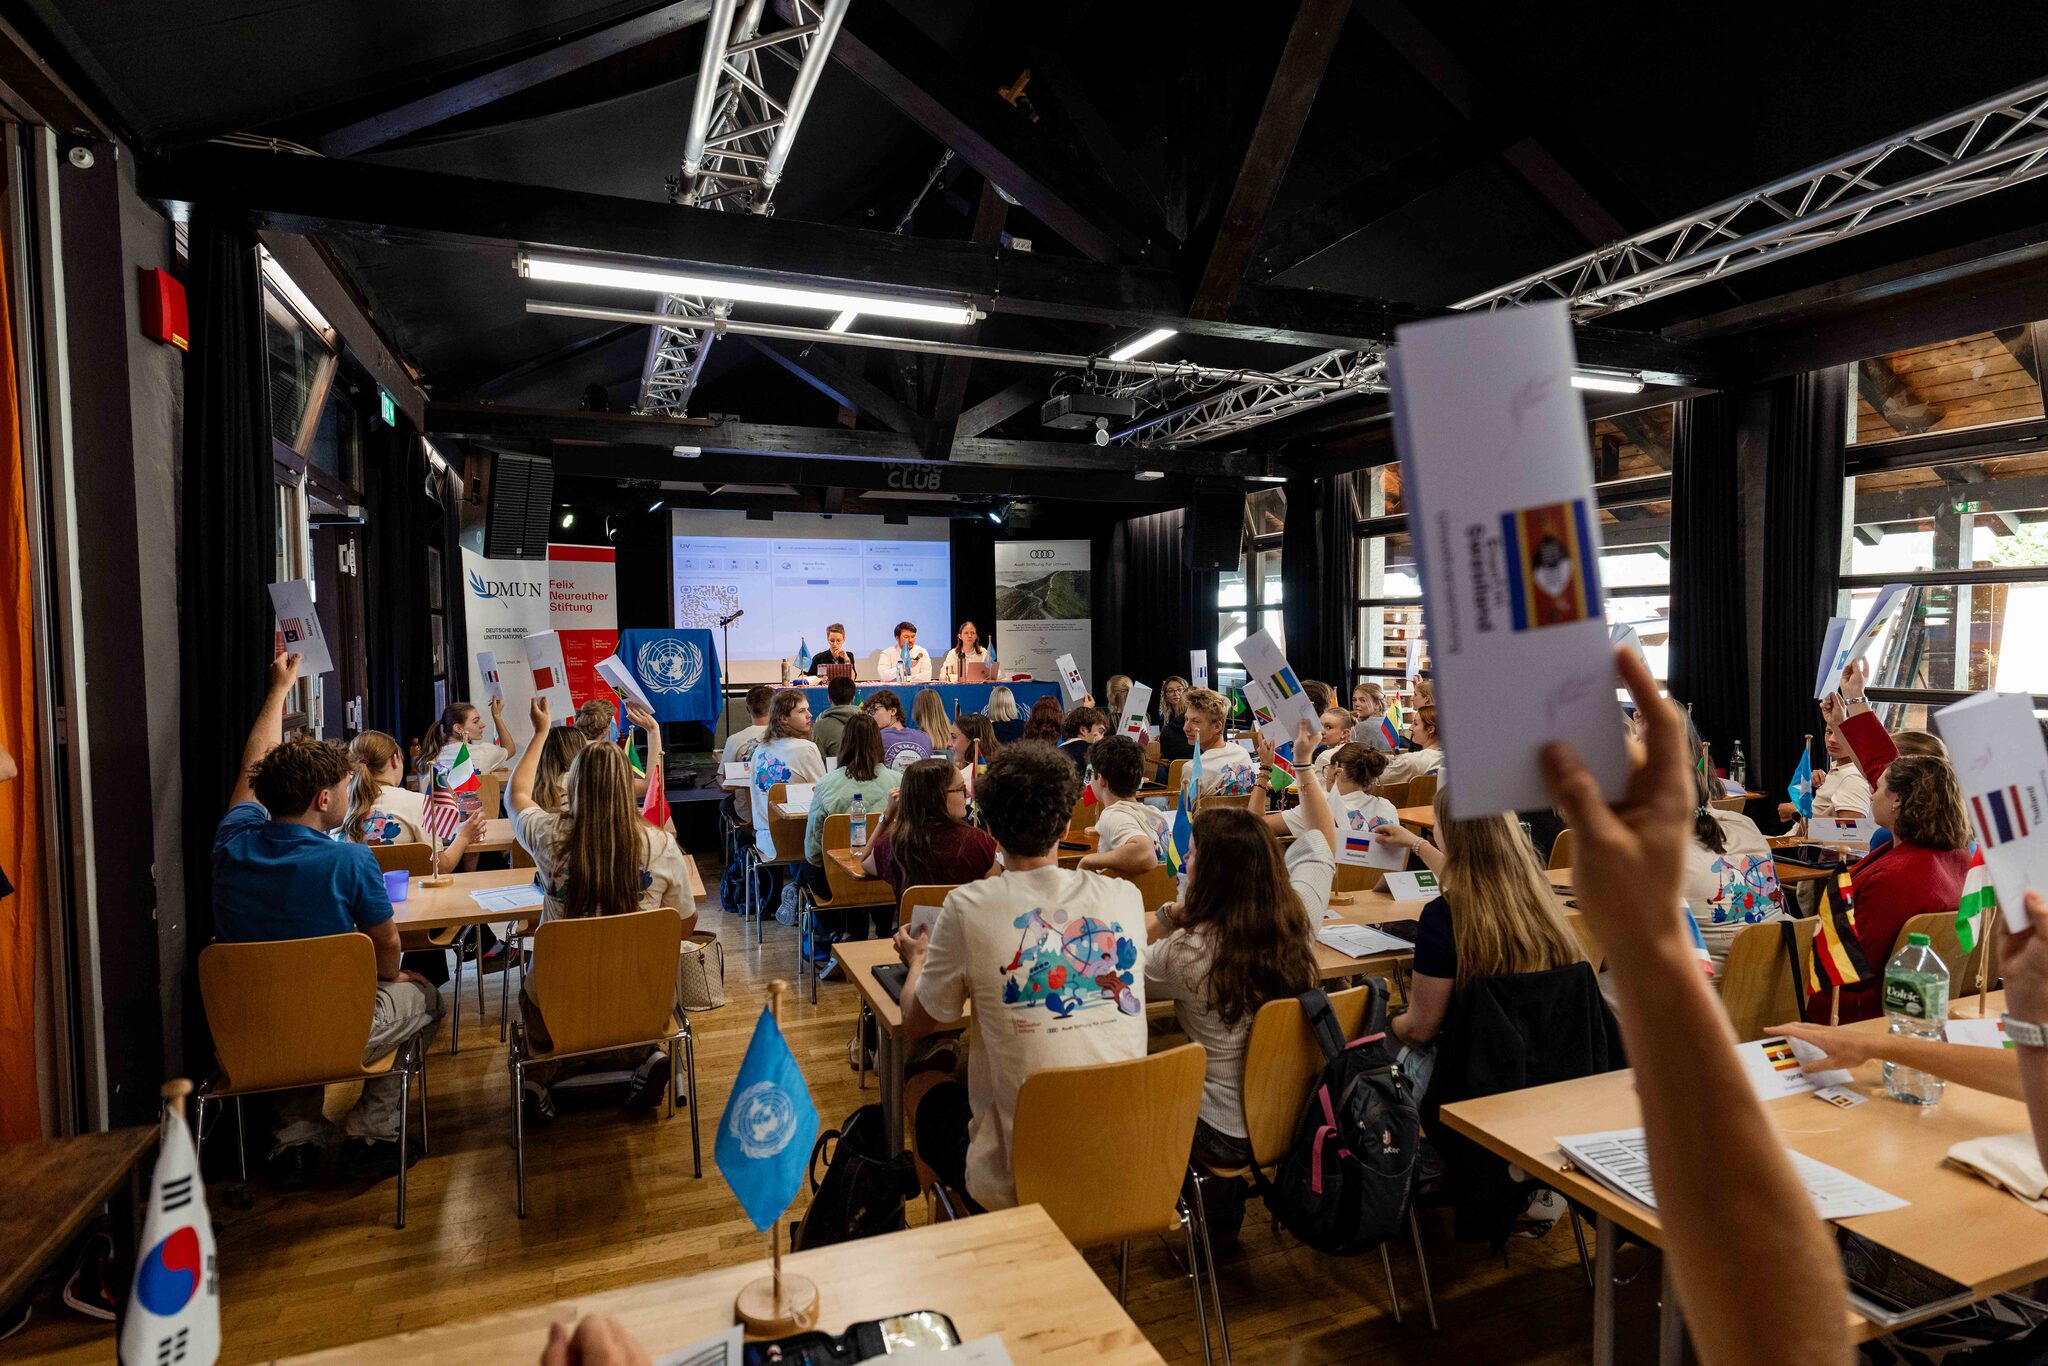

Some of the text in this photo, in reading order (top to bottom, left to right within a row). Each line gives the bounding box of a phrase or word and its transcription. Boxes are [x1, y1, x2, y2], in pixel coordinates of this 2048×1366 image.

[887, 471, 941, 490] CLUB
[486, 581, 542, 598] DMUN
[549, 580, 575, 589] Felix
[549, 591, 609, 601] Neureuther
[549, 602, 593, 614] Stiftung
[1886, 985, 1920, 1002] Volvic
